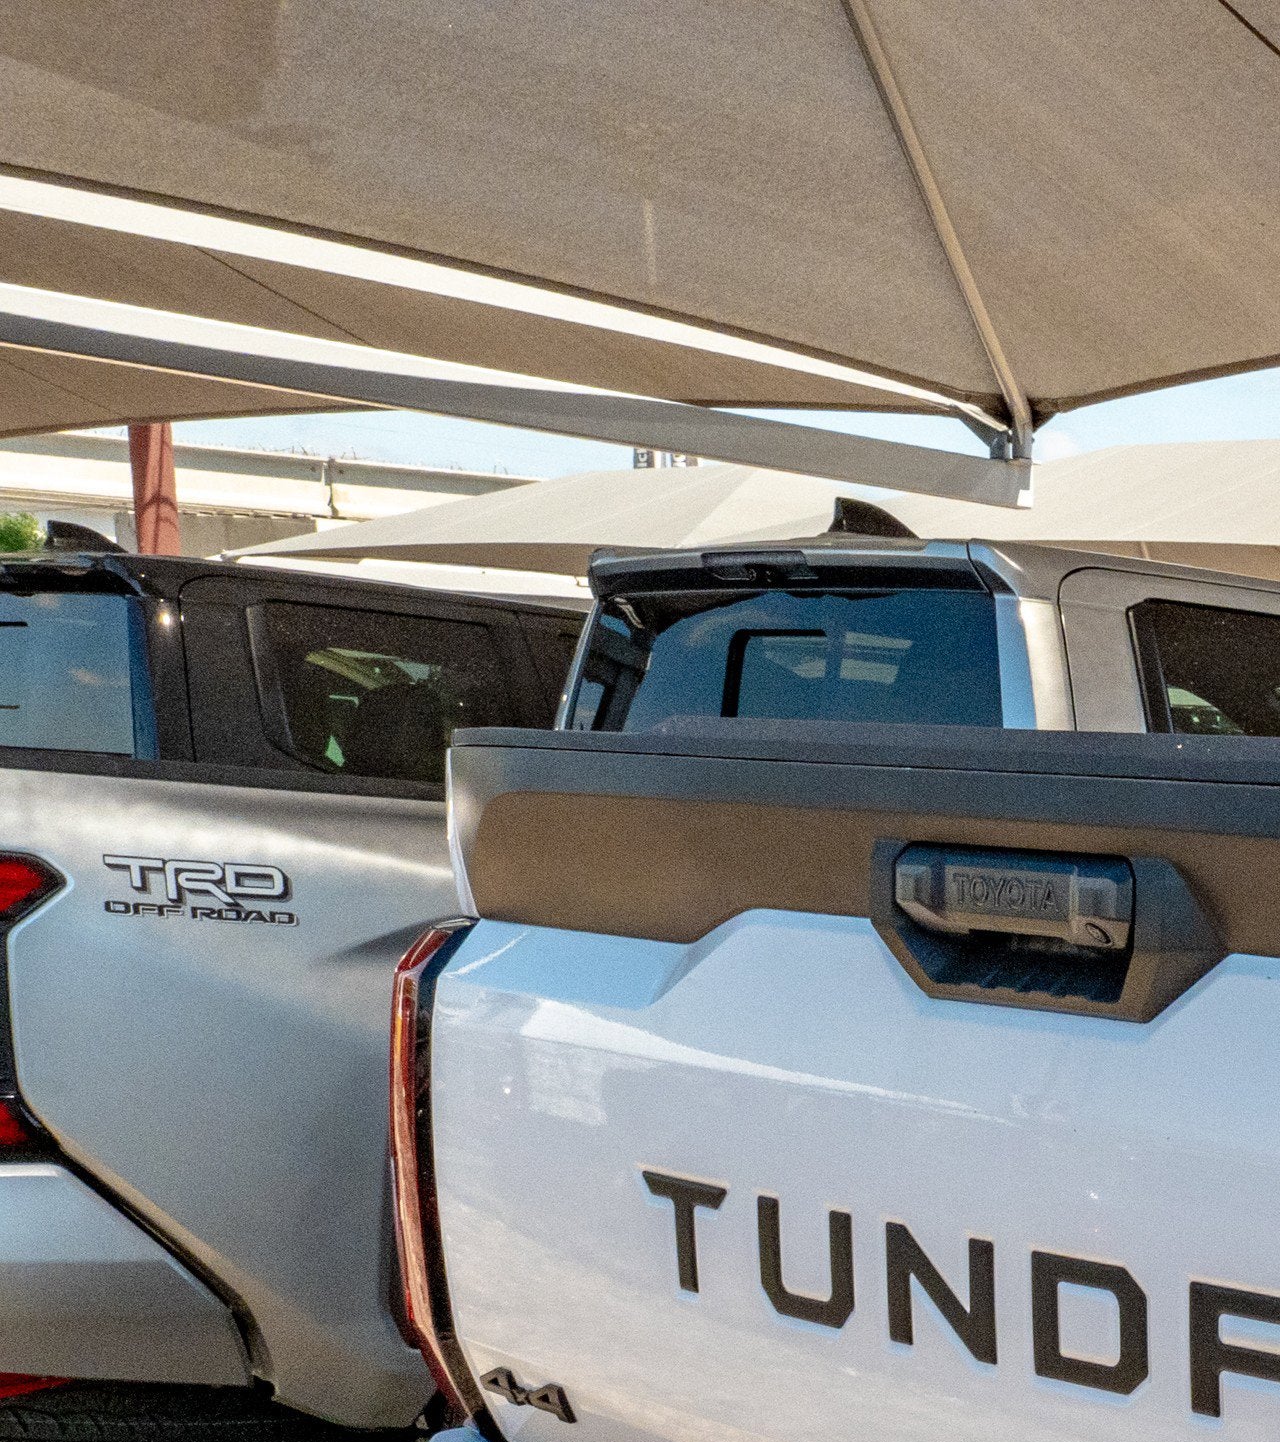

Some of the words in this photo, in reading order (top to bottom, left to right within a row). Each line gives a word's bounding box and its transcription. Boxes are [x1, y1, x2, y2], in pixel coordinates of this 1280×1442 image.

[103, 854, 292, 909] TRD
[952, 870, 1063, 912] TOYOTA
[103, 900, 185, 918] OFF
[191, 906, 299, 926] ROAD
